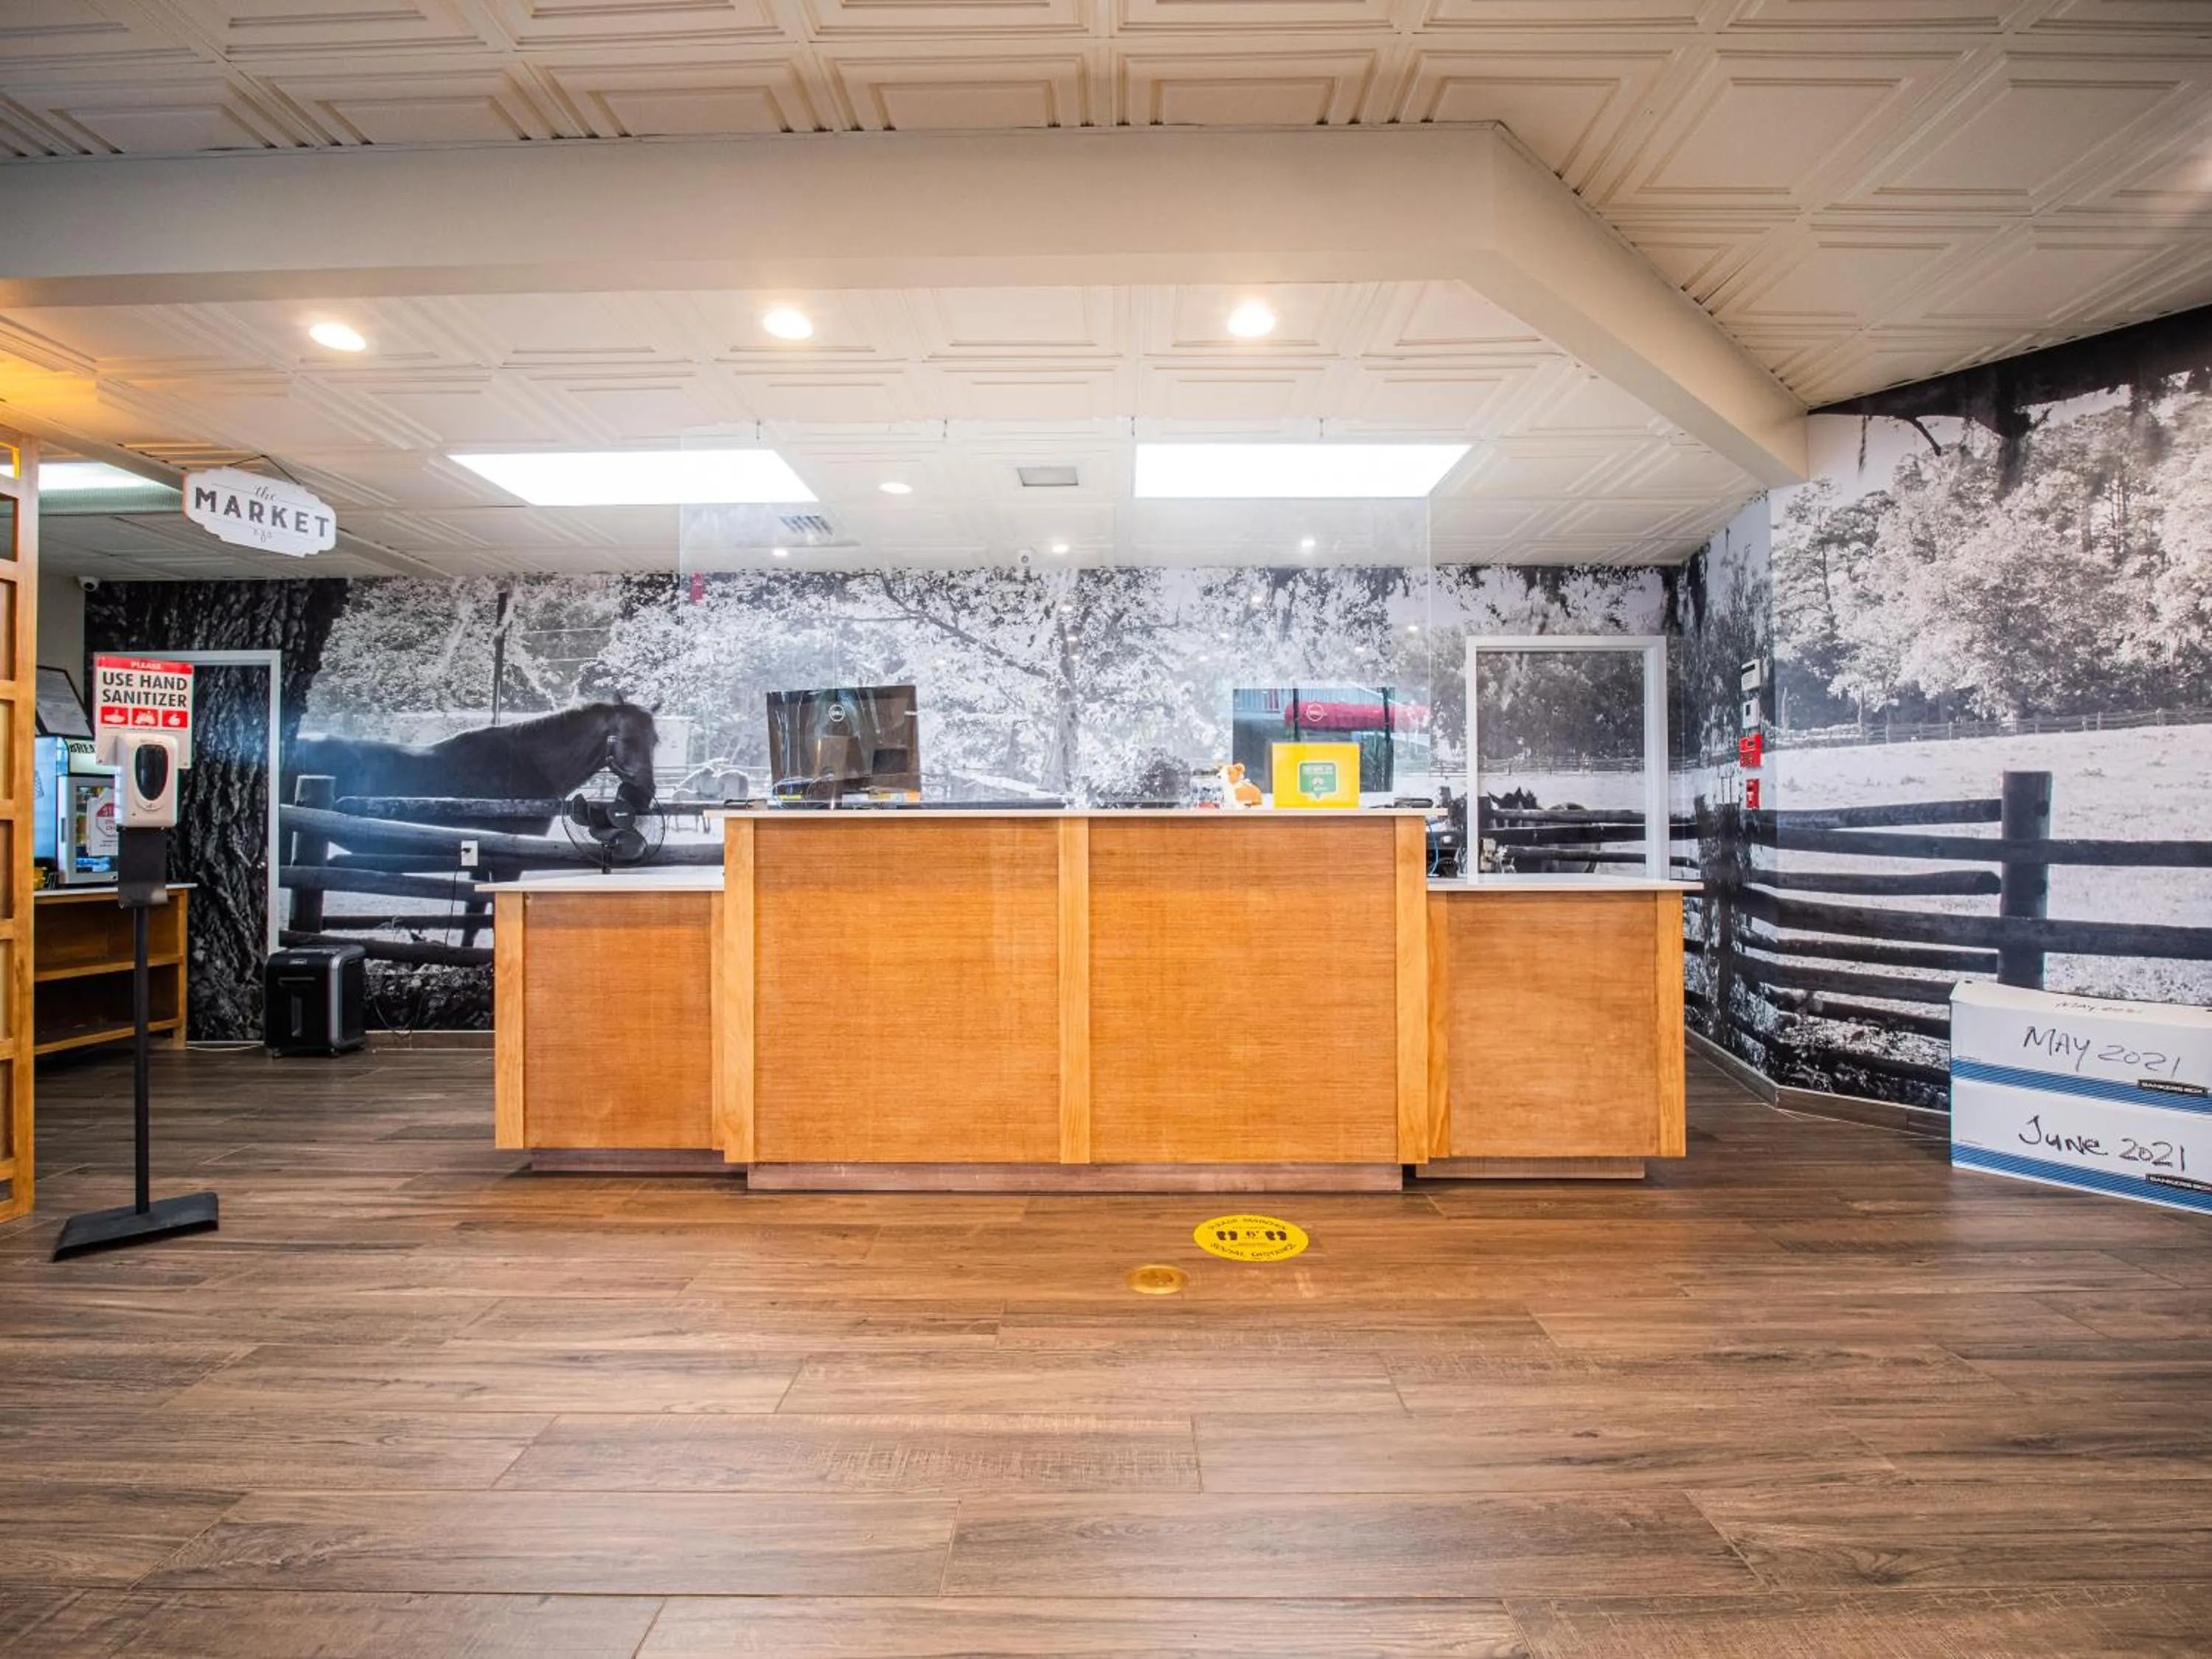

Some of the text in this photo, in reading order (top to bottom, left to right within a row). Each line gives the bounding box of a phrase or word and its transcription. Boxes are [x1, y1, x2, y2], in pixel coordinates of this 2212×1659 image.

[254, 486, 276, 501] the
[195, 487, 329, 537] MARKET
[102, 672, 187, 691] USE HAND
[102, 689, 187, 707] SANITIZER
[2023, 1026, 2180, 1078] MAY 2021
[2119, 1138, 2185, 1171] 2021
